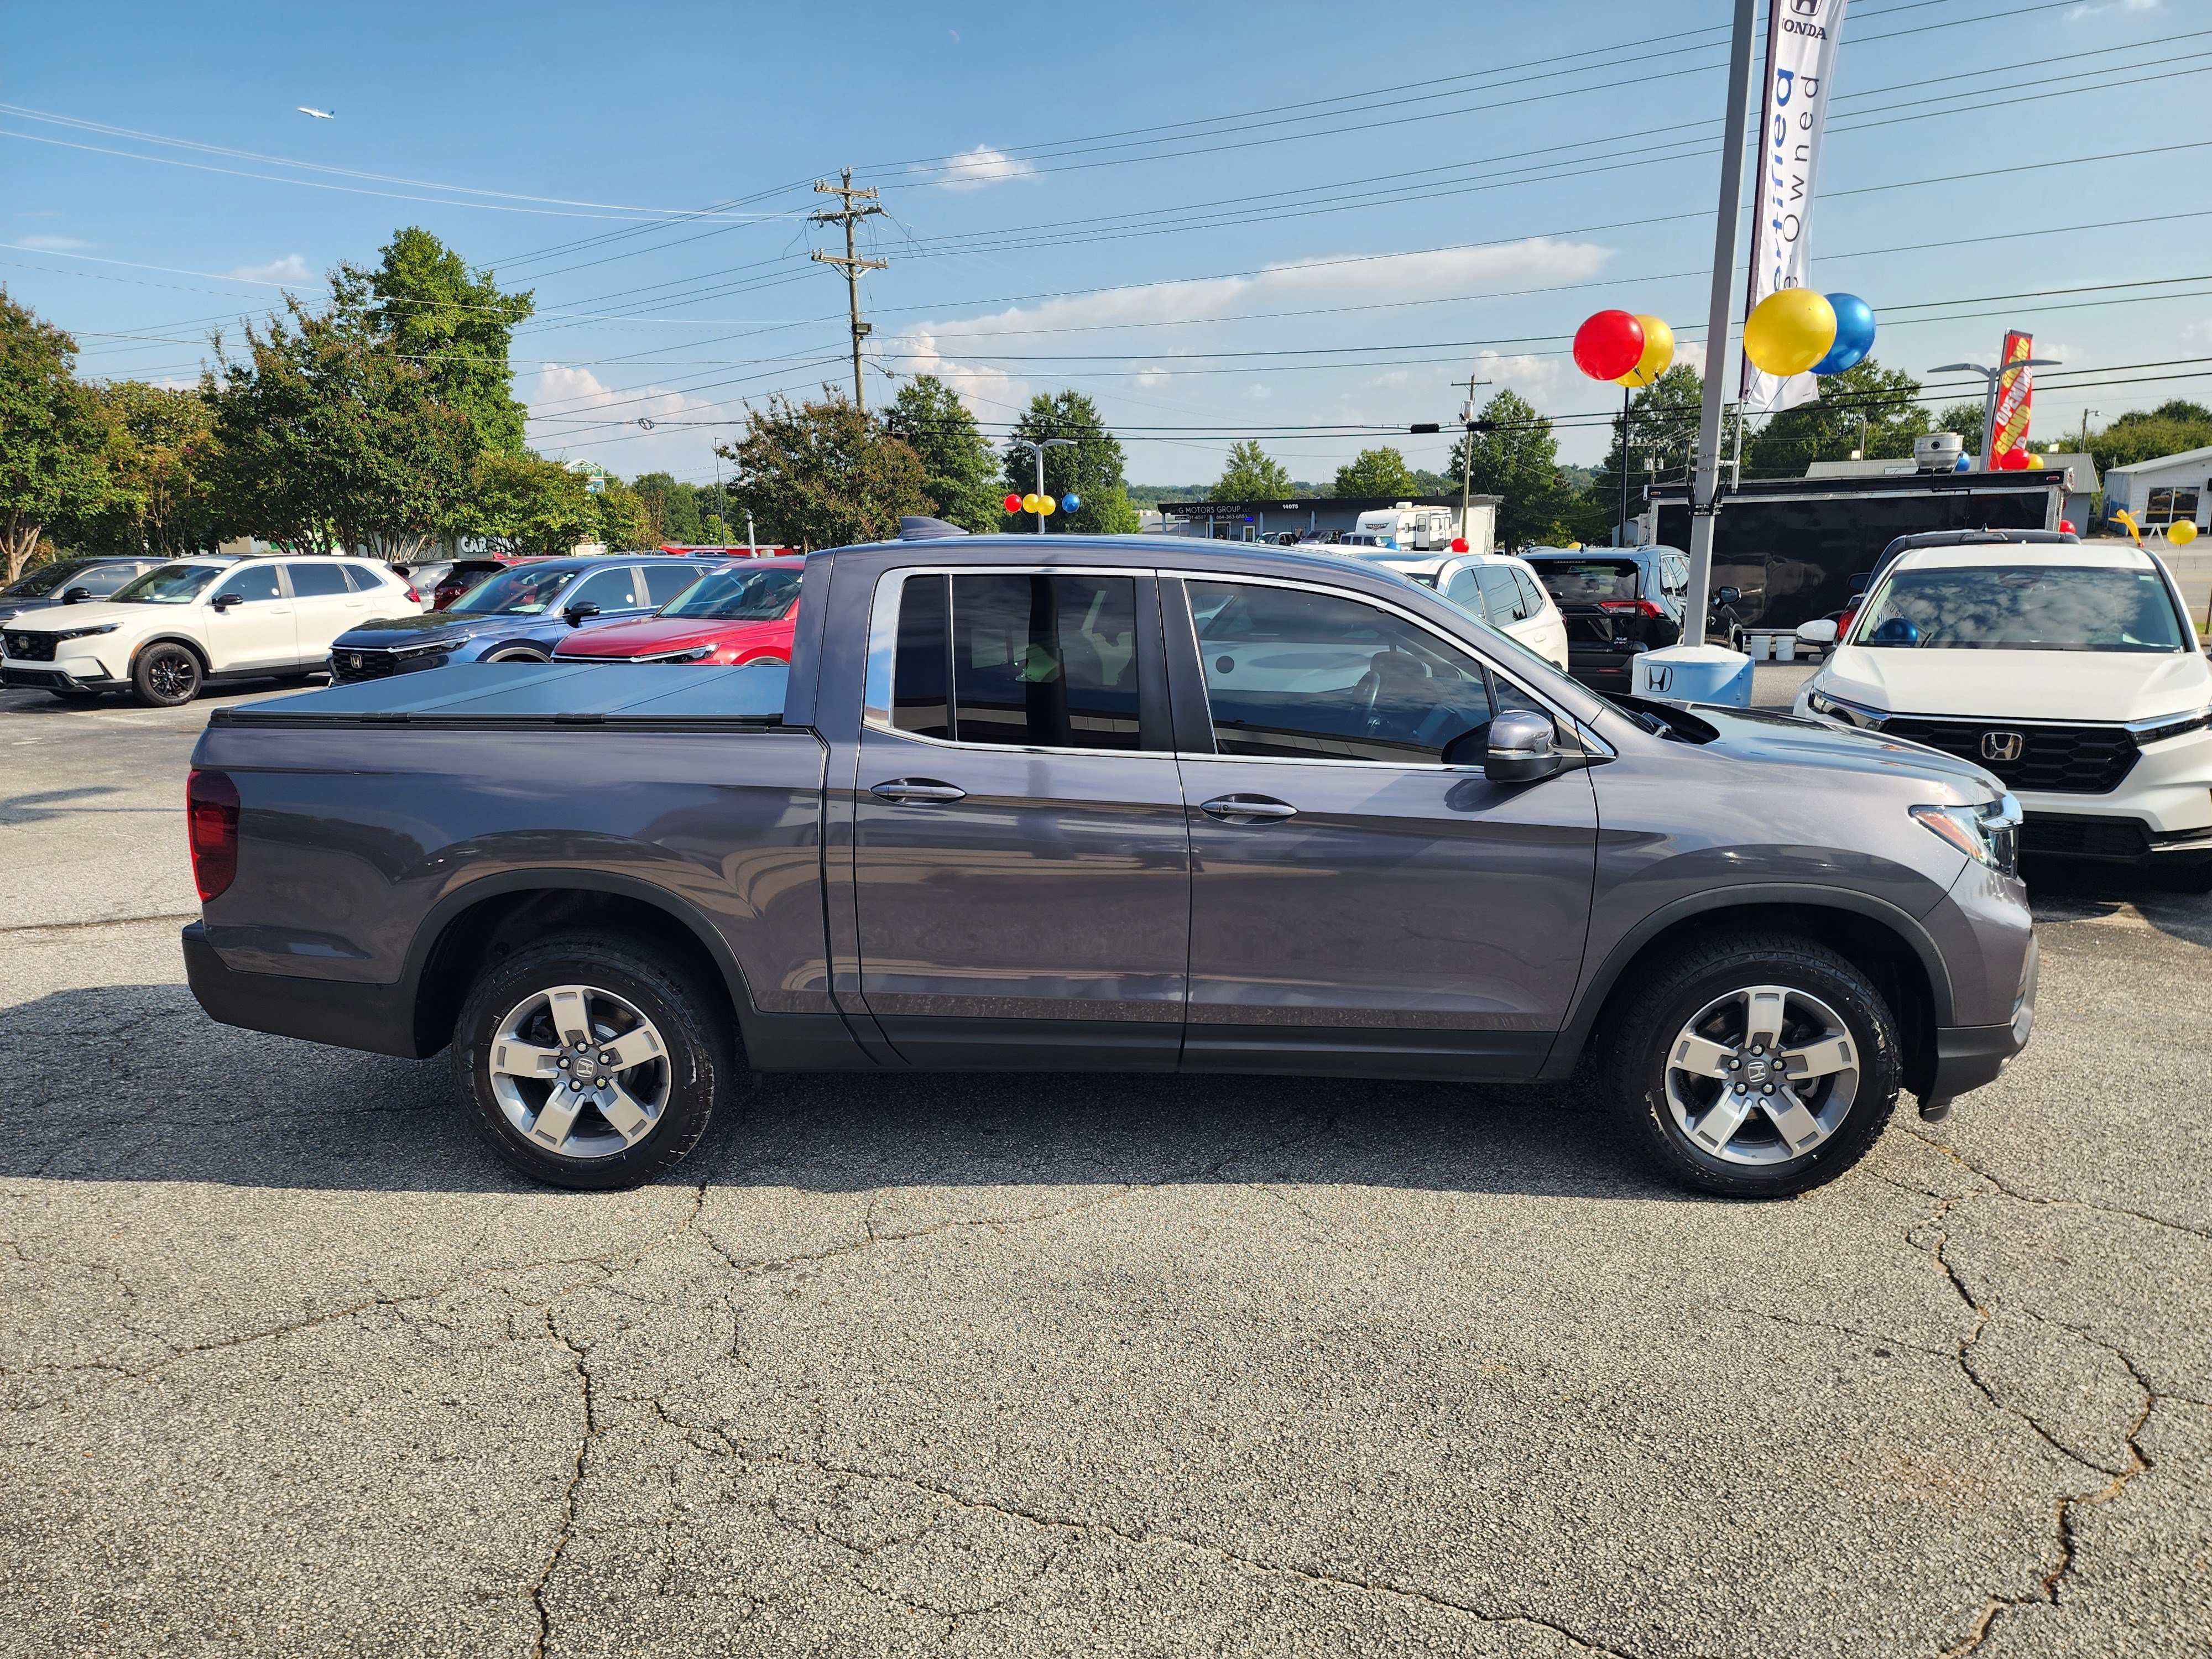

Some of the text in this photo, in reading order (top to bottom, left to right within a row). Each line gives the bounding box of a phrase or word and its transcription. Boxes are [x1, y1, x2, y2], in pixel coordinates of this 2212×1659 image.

[1781, 18, 1827, 40] ONDA
[1771, 67, 1794, 292] ertified
[1783, 76, 1819, 289] e-Owned
[1995, 404, 2031, 455] GRAND
[1186, 505, 1215, 514] MOTORS
[1217, 505, 1241, 513] GROUP
[461, 536, 488, 552] CAR
